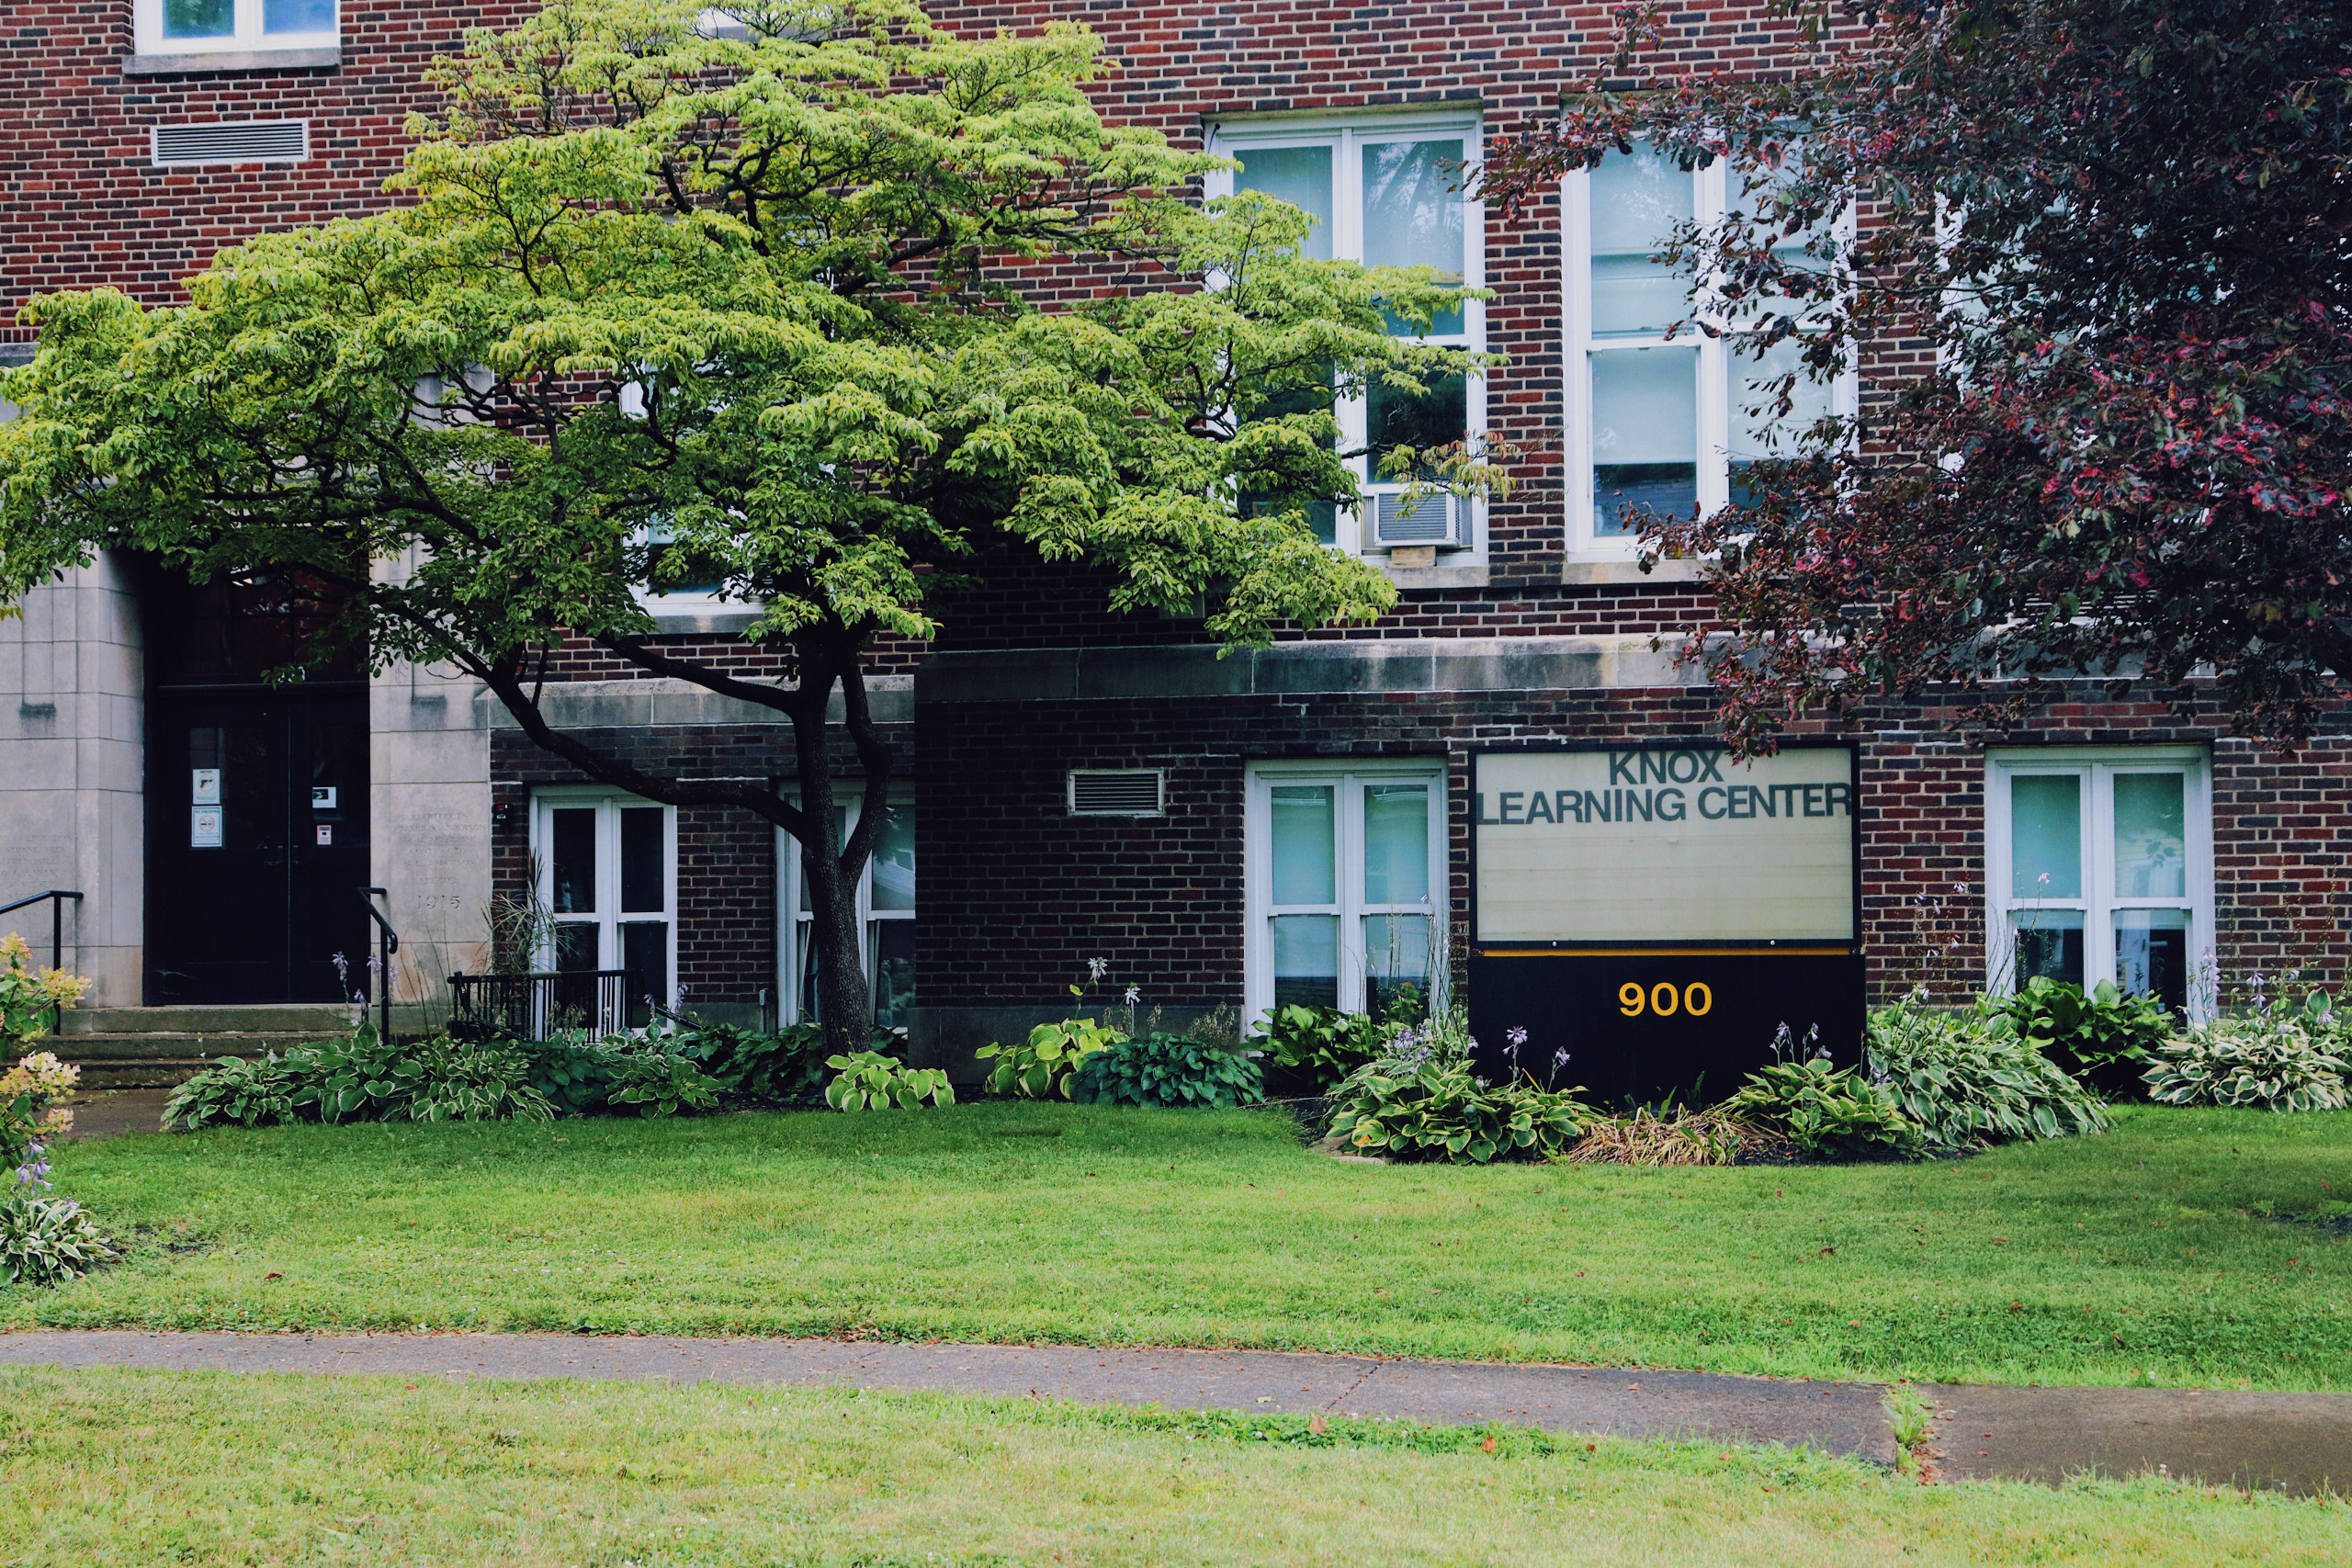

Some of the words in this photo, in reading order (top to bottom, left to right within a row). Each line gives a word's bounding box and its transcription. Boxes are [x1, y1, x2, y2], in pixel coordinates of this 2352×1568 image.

[1609, 750, 1725, 785] KNOX
[1476, 787, 1688, 825] LEARNING
[1698, 782, 1852, 820] CENTER
[417, 895, 461, 910] 1915
[1618, 982, 1713, 1016] 900
